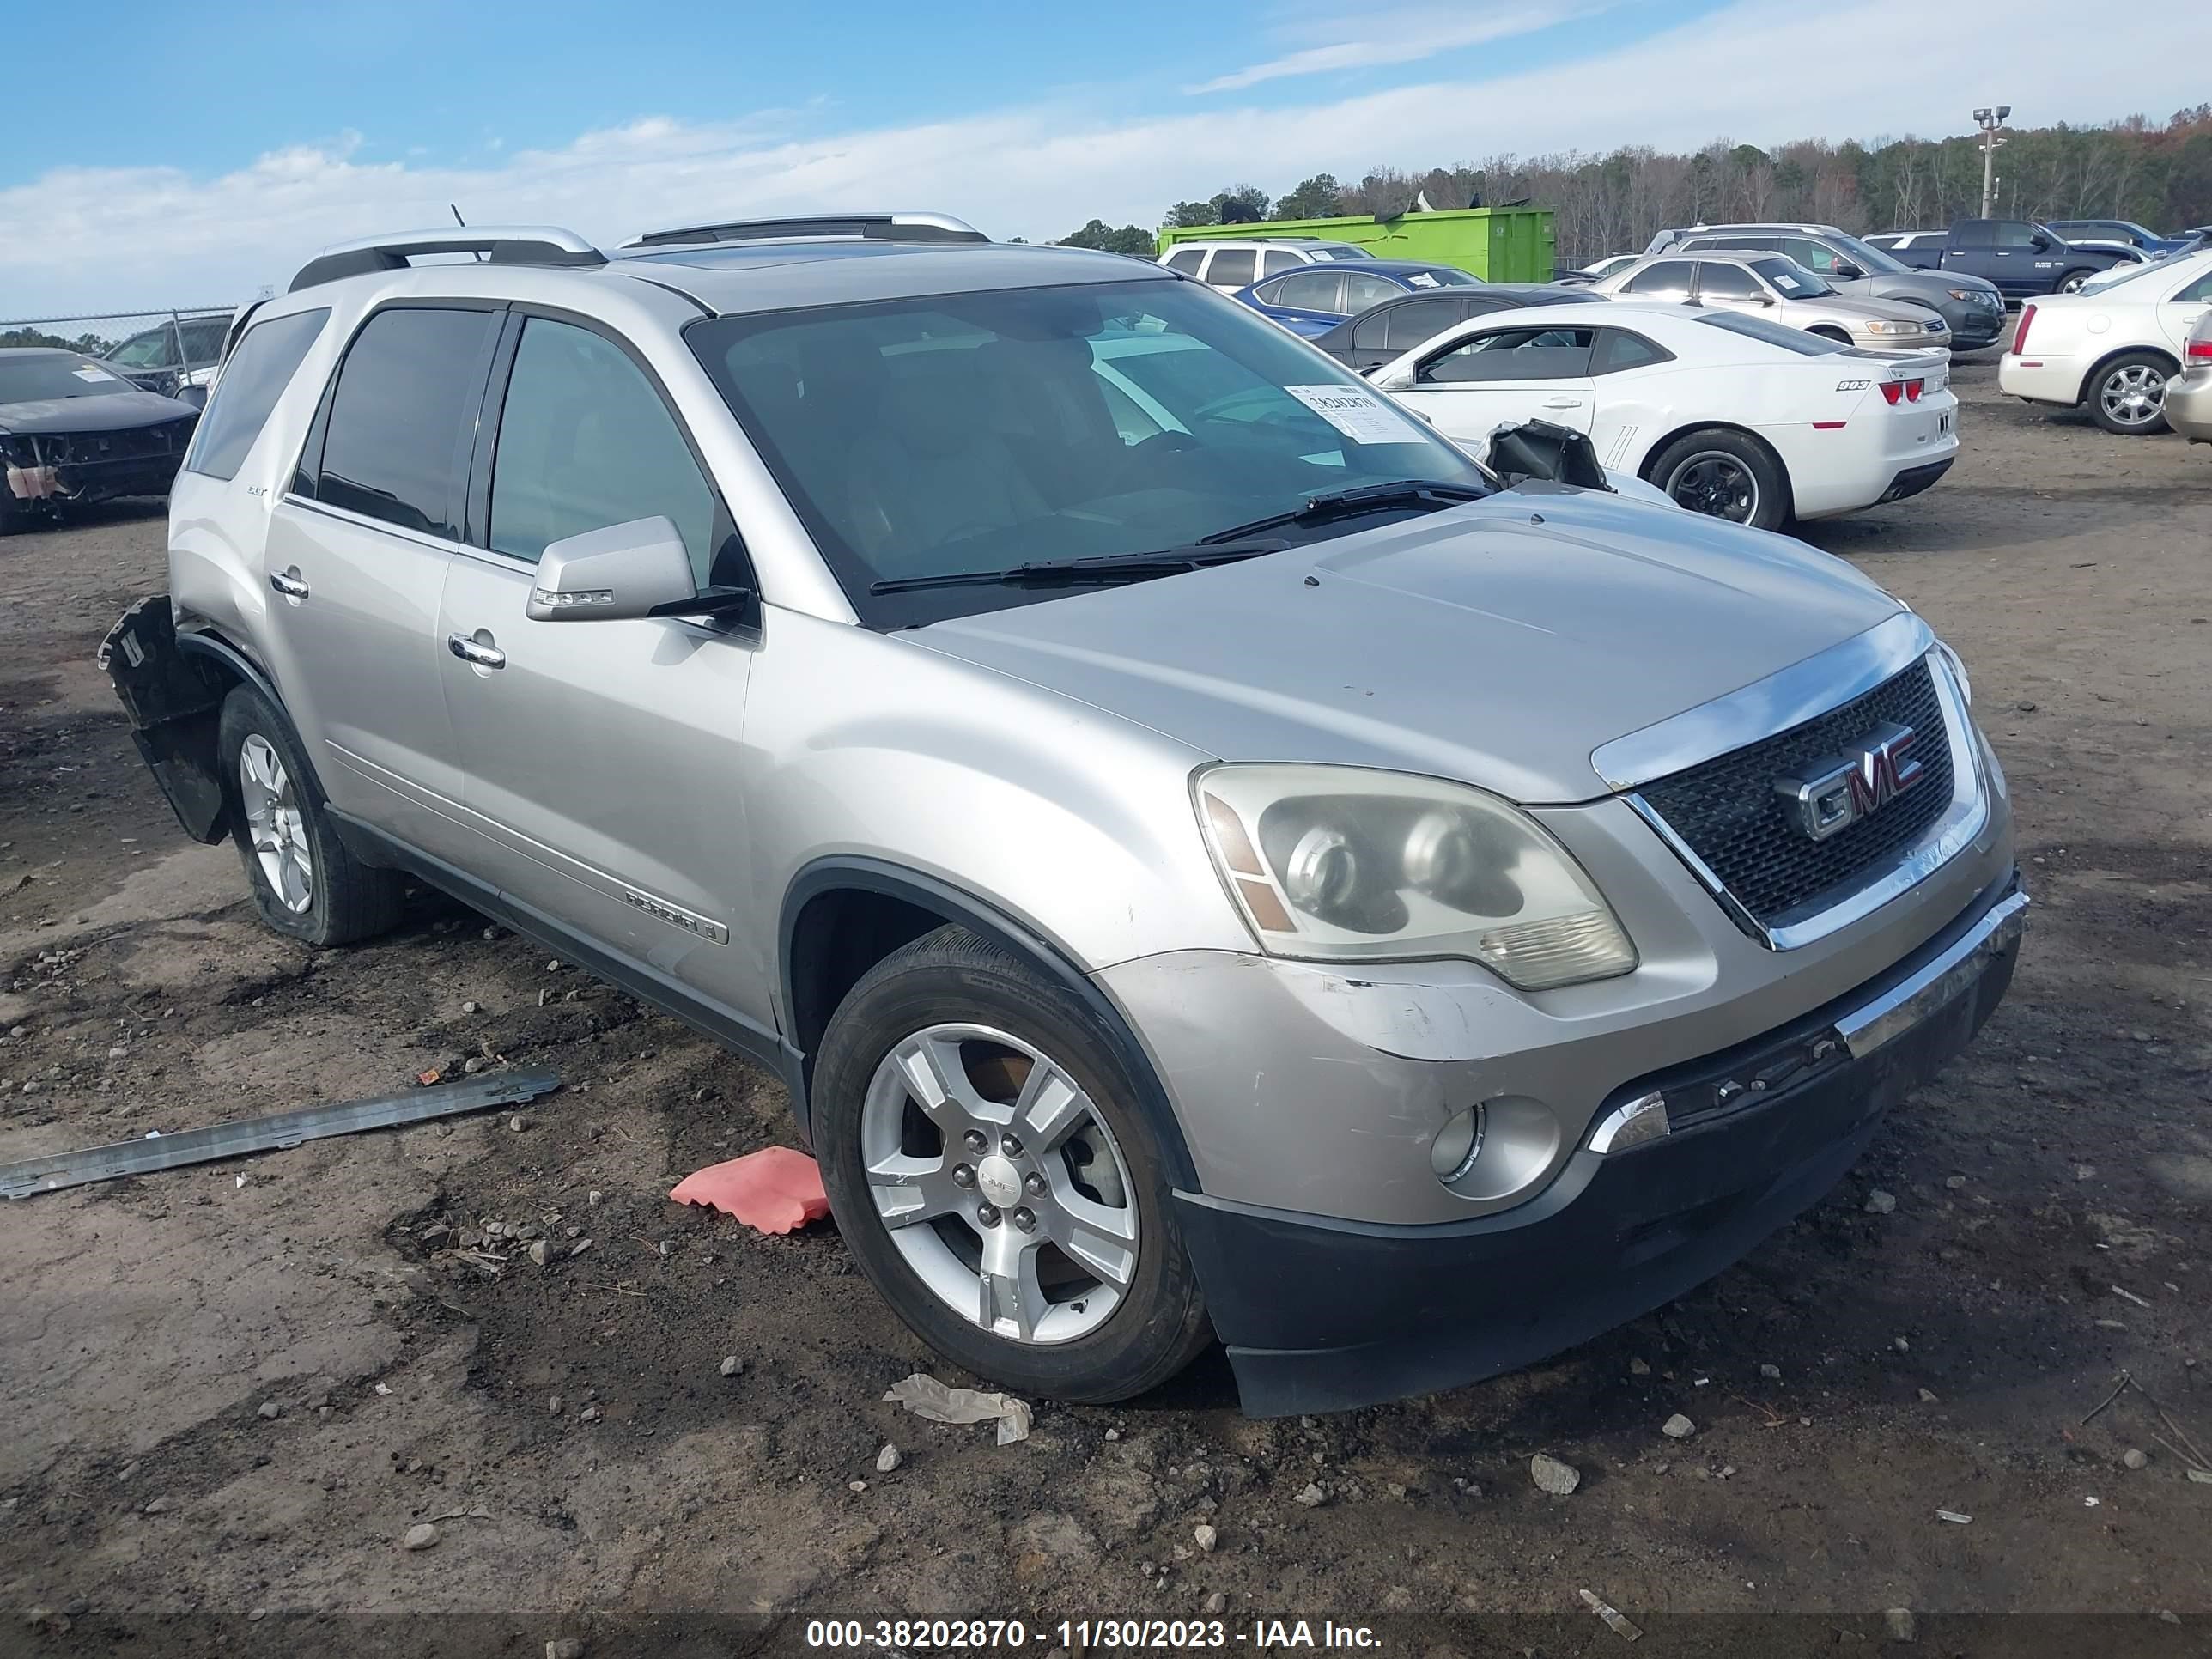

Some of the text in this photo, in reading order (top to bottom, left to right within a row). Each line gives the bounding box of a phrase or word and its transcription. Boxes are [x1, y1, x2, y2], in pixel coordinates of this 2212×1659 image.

[1838, 380, 1869, 391] 903
[1309, 397, 1377, 410] 38202870
[1798, 726, 1925, 842] GMC
[981, 1172, 1017, 1195] GMC
